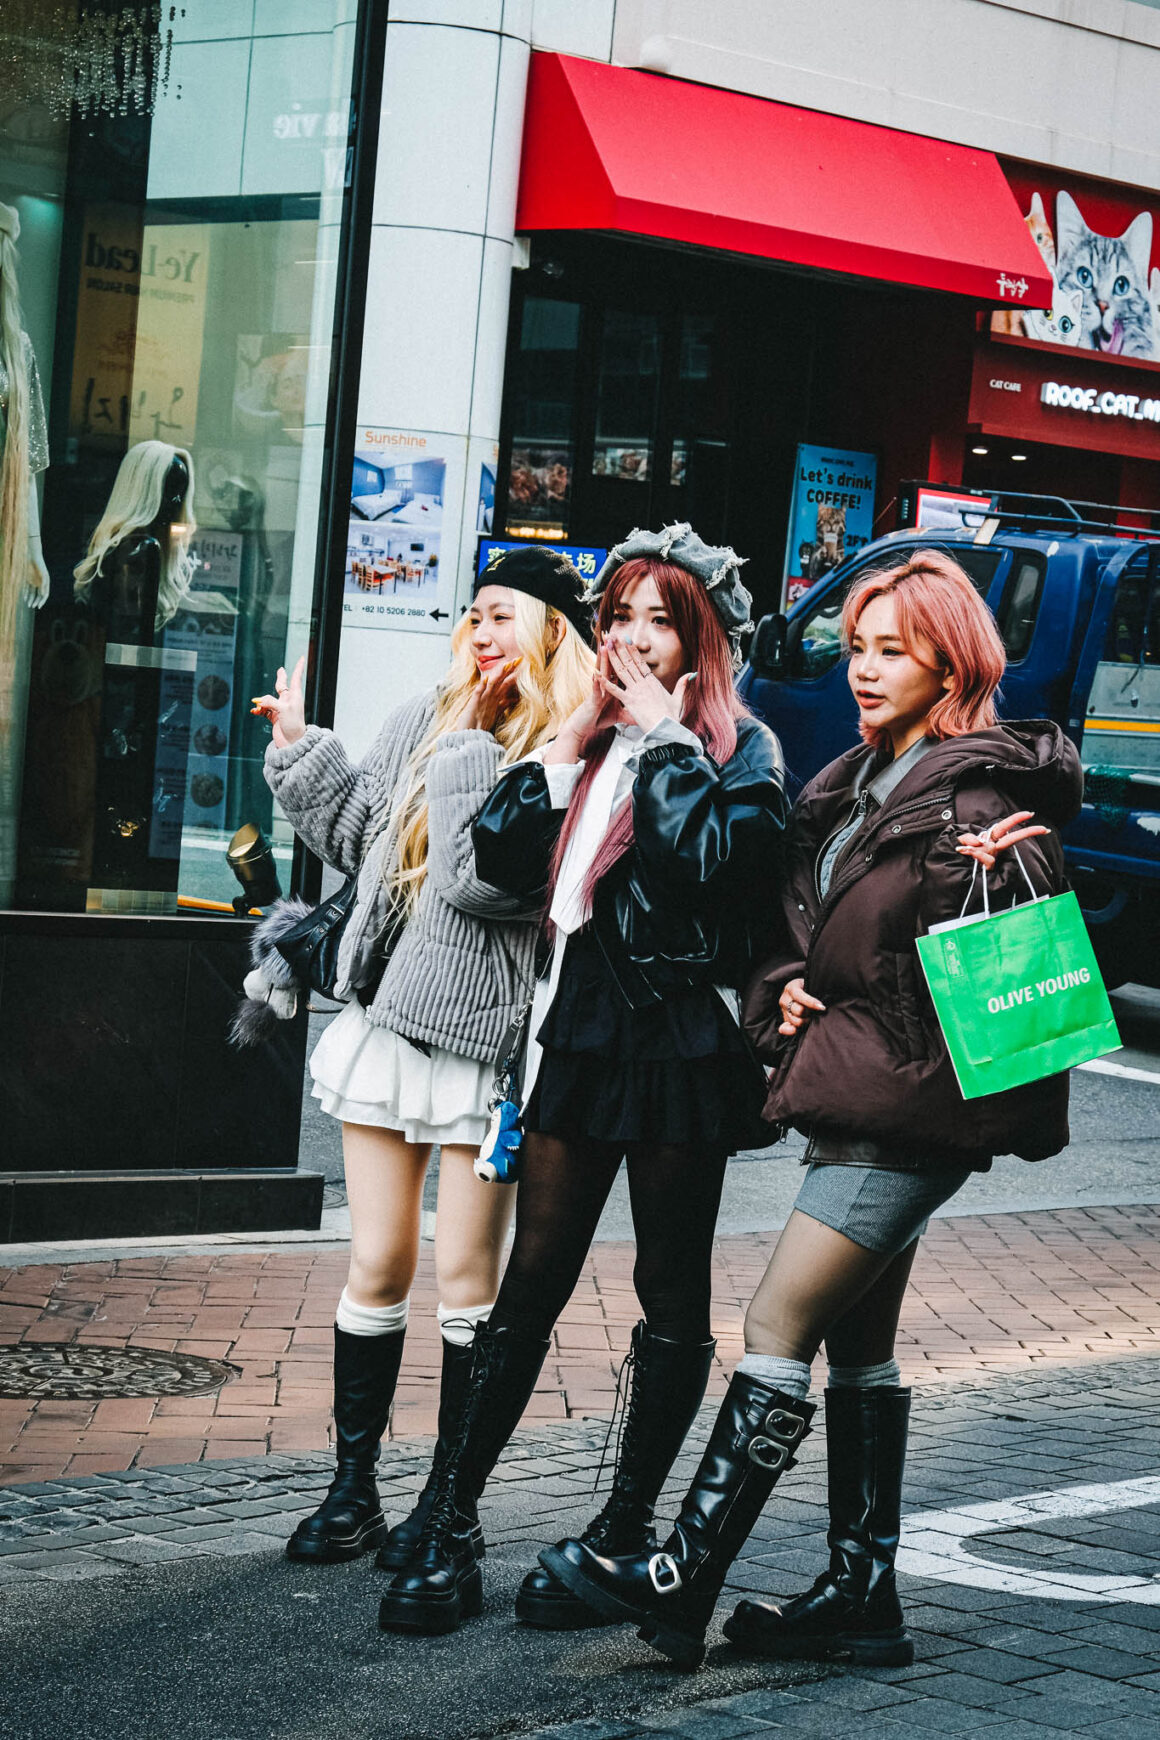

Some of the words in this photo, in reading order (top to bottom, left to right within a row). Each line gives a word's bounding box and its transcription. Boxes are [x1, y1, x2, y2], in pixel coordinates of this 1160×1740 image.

[365, 431, 427, 447] Sunshine
[801, 467, 834, 485] Let's
[837, 472, 872, 490] drink
[387, 607, 405, 615] 5206
[987, 986, 1034, 1014] OLIVE
[1035, 967, 1091, 998] YOUNG
